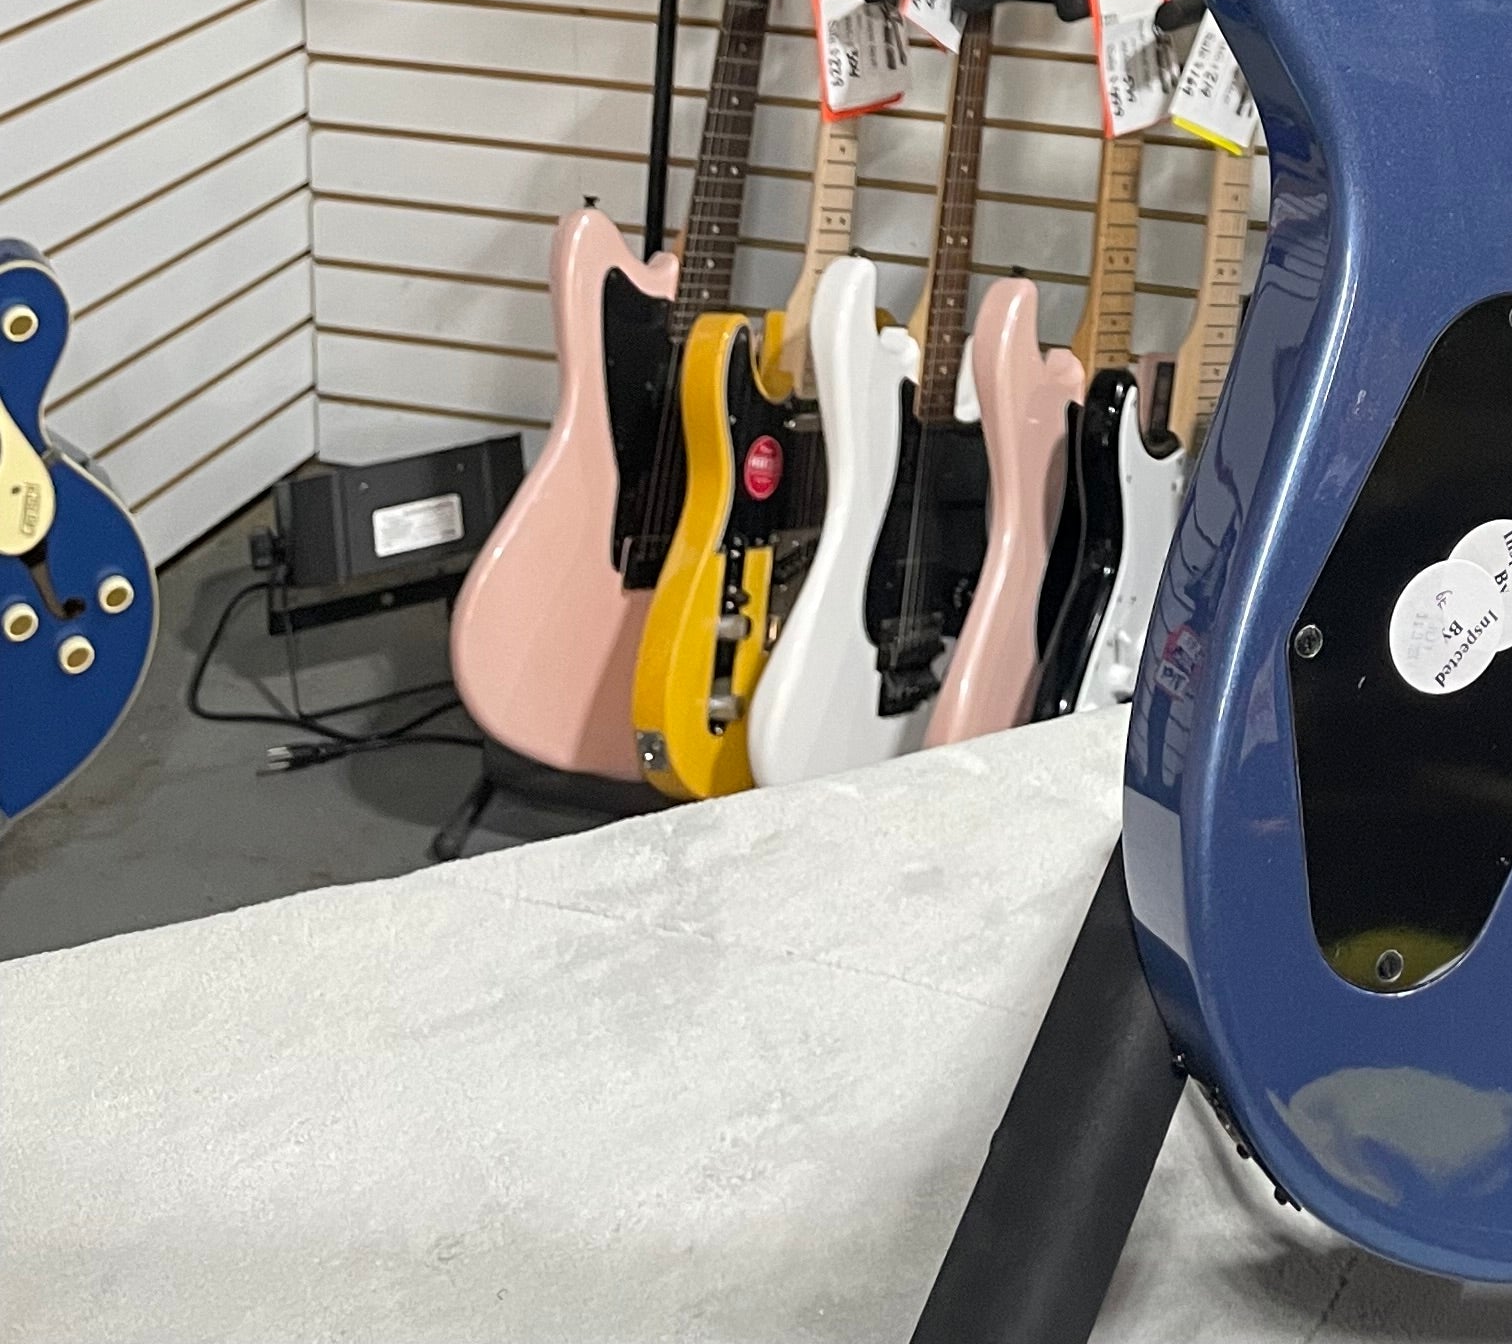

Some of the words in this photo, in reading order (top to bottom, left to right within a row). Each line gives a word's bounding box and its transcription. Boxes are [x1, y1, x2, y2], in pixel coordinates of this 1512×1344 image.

[1494, 569, 1511, 595] By
[1442, 619, 1464, 644] By
[1434, 609, 1499, 688] Inspected
